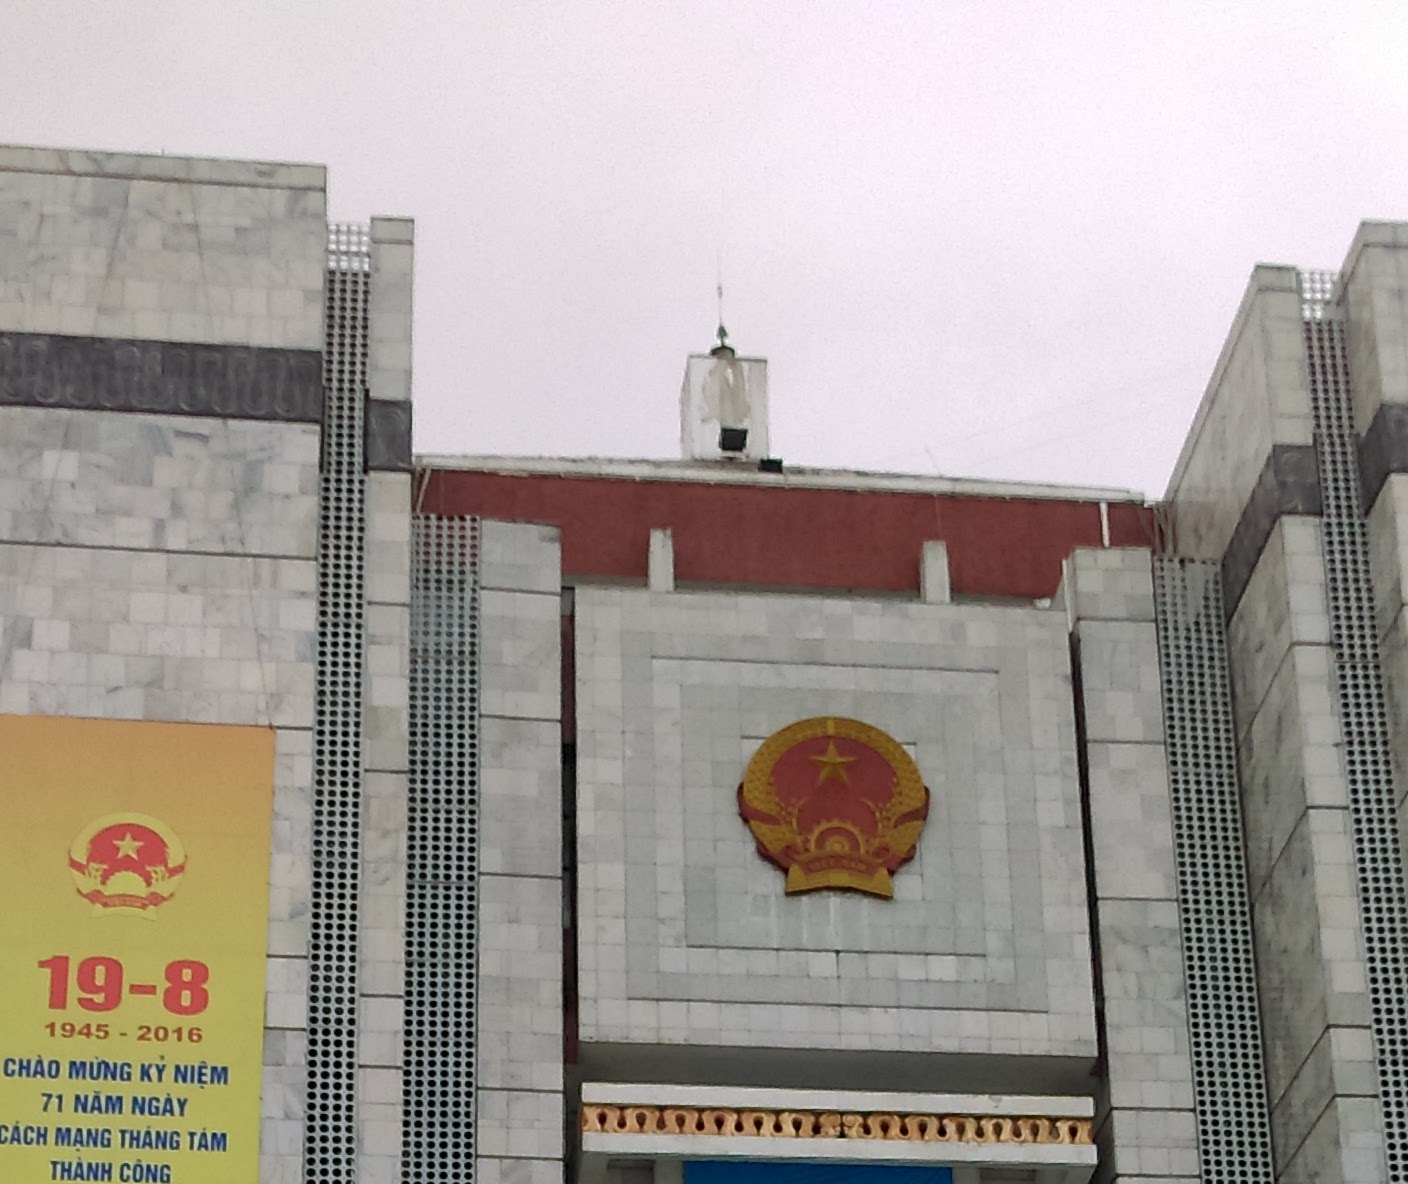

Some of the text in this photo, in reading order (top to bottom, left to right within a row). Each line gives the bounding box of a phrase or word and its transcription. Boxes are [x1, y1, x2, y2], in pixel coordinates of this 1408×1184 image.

[38, 955, 210, 1016] 19-8
[45, 1022, 109, 1040] 1945
[137, 1025, 202, 1043] 2016
[3, 1054, 228, 1089] CHÀO MỪNG KỶ NIỆM
[41, 1090, 188, 1117] 71 NĂM NGÀY
[55, 1126, 112, 1152] MẠNG
[119, 1125, 180, 1150] THÁNG
[188, 1127, 227, 1152] TÁM
[50, 1156, 171, 1184] THÀNH CÔNG
